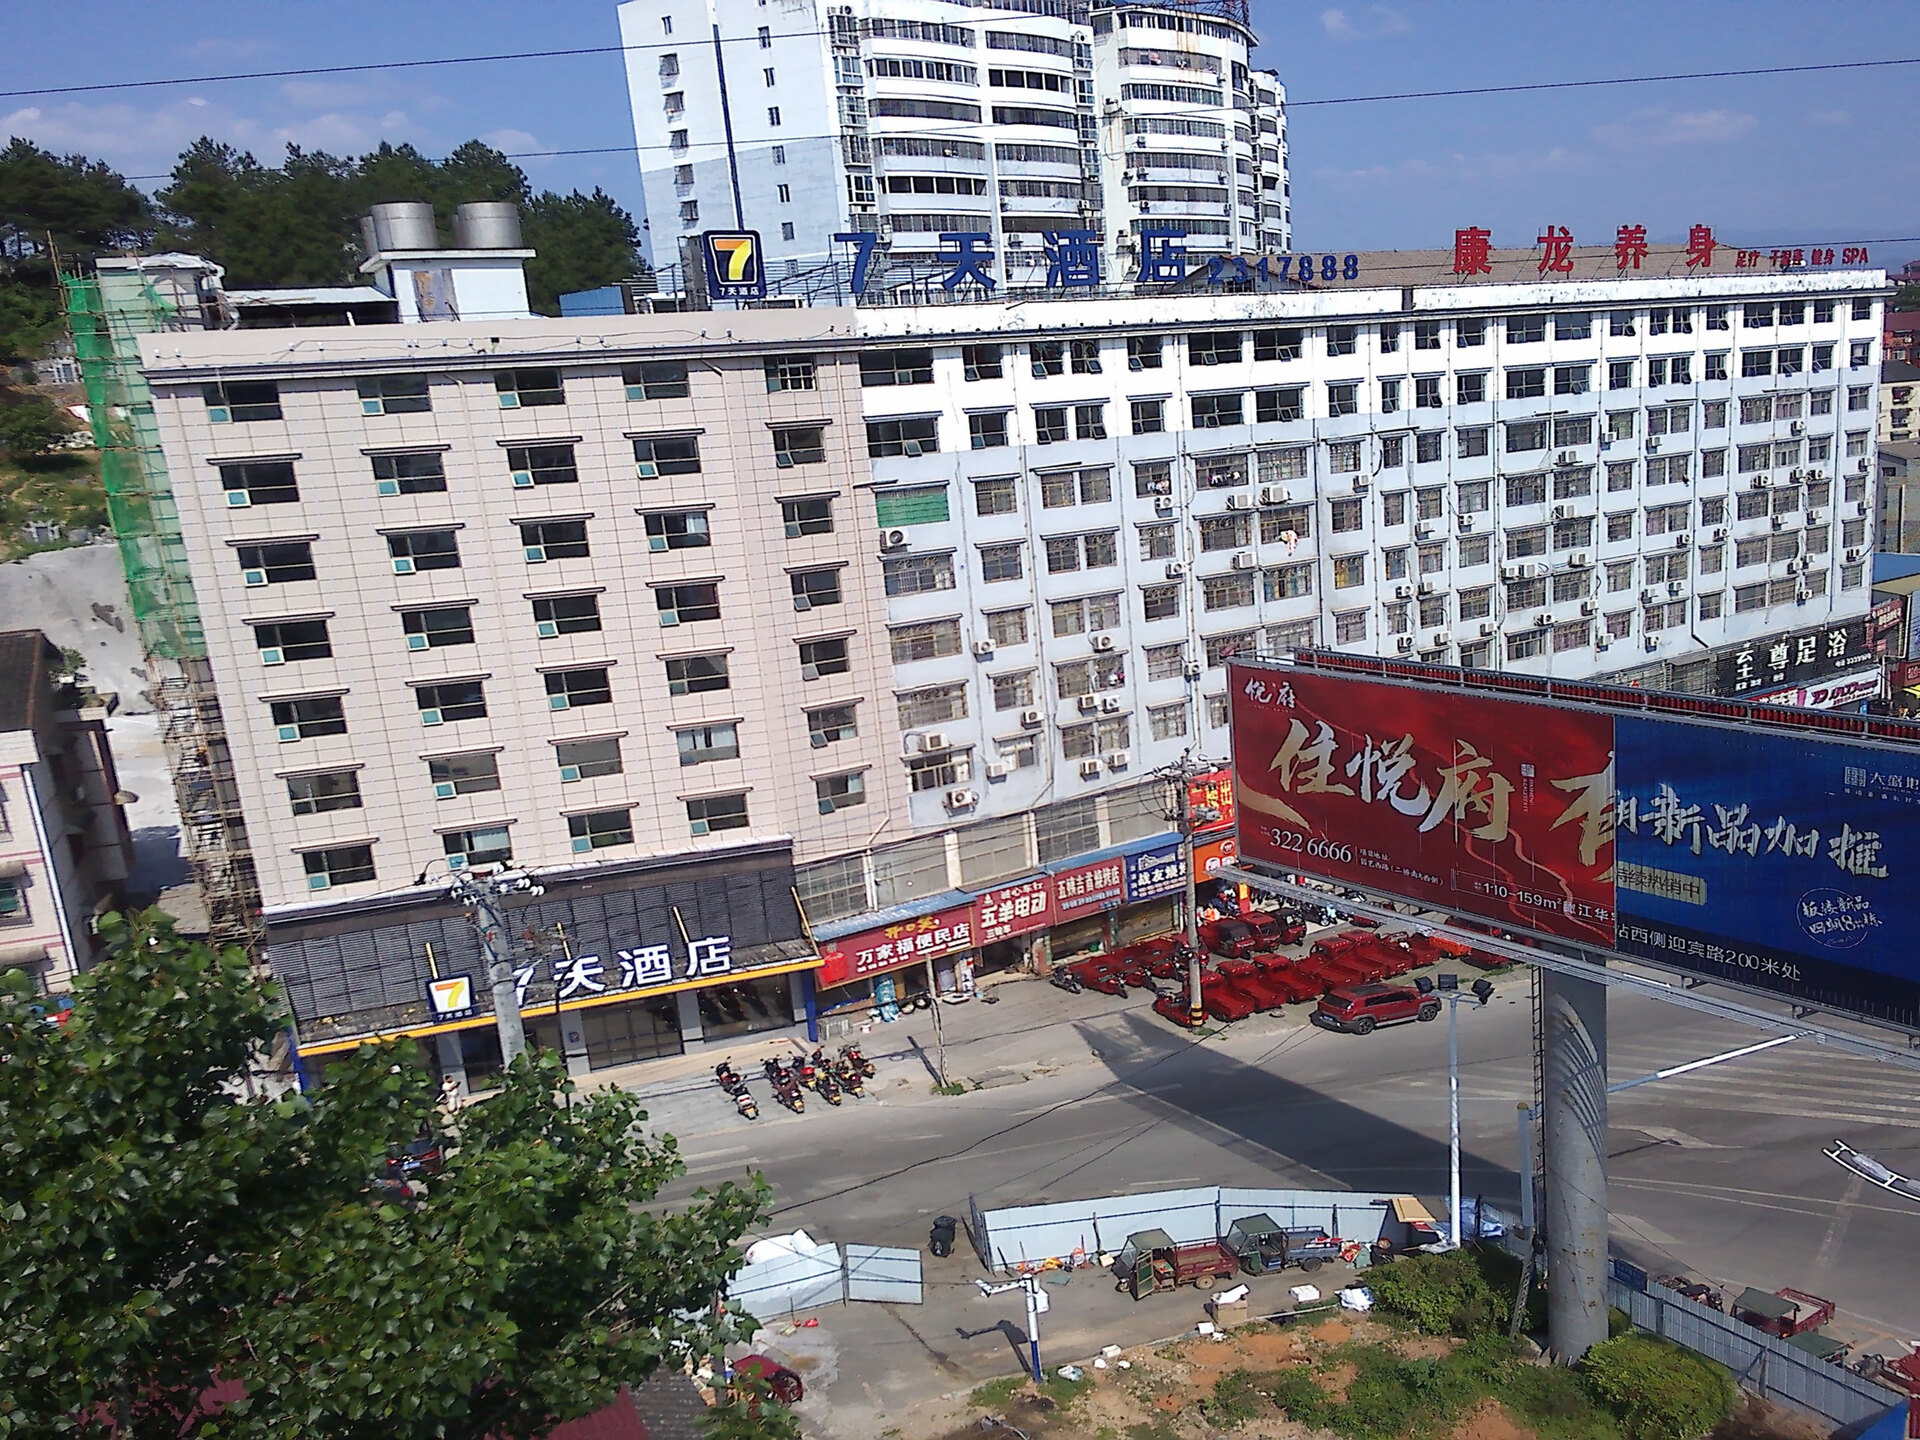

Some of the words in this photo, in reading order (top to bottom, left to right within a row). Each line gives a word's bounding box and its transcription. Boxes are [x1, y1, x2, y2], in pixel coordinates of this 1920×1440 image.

[714, 239, 751, 280] 7
[834, 227, 1188, 293] 7天酒店
[1207, 253, 1359, 285] 2317888
[1453, 224, 1717, 276] 康龙养身
[1841, 247, 1869, 264] SPA
[718, 286, 760, 296] 7天酒店
[1267, 717, 1516, 842] 住悦府
[1270, 828, 1303, 853] 322
[1306, 837, 1352, 863] 6666
[981, 891, 1047, 929] 五羊电动
[1563, 901, 1615, 922] 瞰江华
[855, 923, 971, 966] 万家福便民店
[512, 936, 731, 1007] 7天酒店
